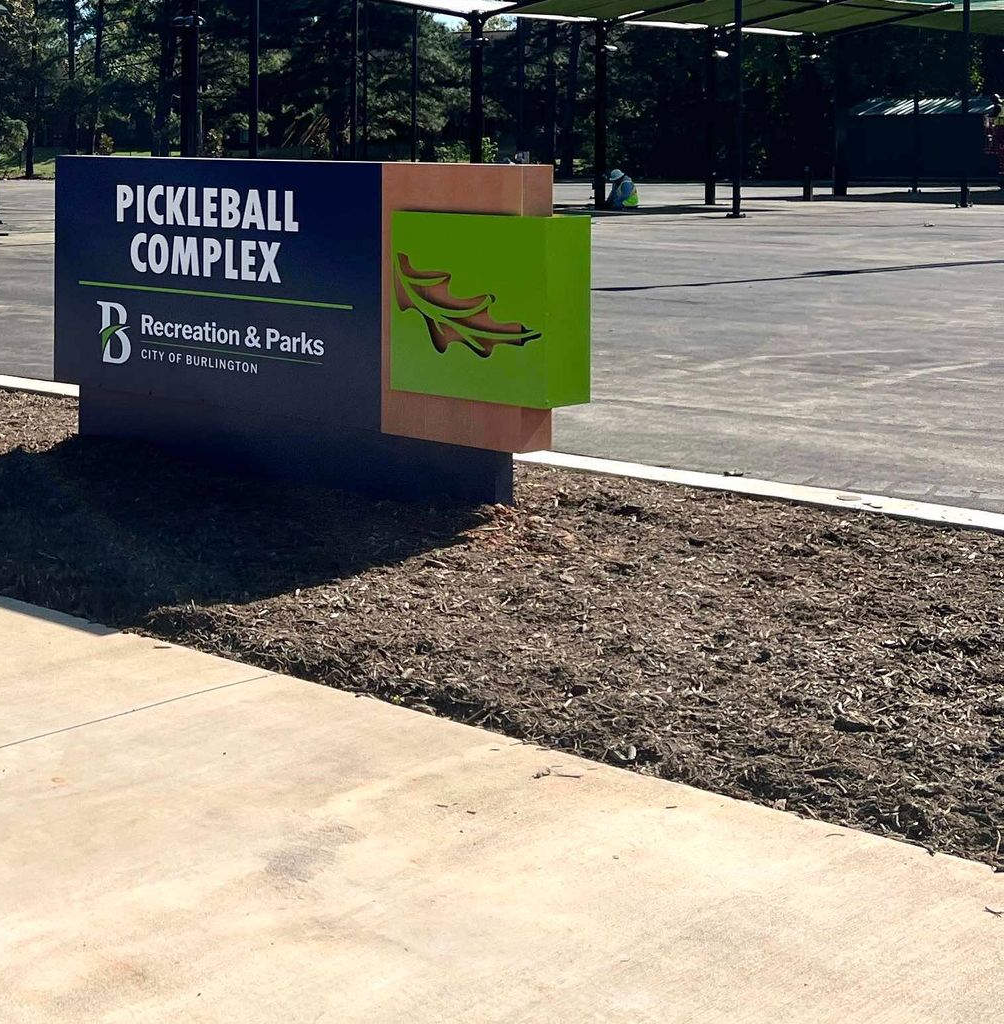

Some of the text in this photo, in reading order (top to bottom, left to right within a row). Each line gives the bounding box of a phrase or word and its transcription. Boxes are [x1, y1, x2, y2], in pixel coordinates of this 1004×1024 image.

[116, 184, 299, 232] PICKLEBALL
[130, 232, 282, 284] COMPLEX
[96, 300, 132, 364] B
[141, 314, 325, 357] Recreation & Parks
[140, 348, 259, 375] CITY OF BURLINGTON
